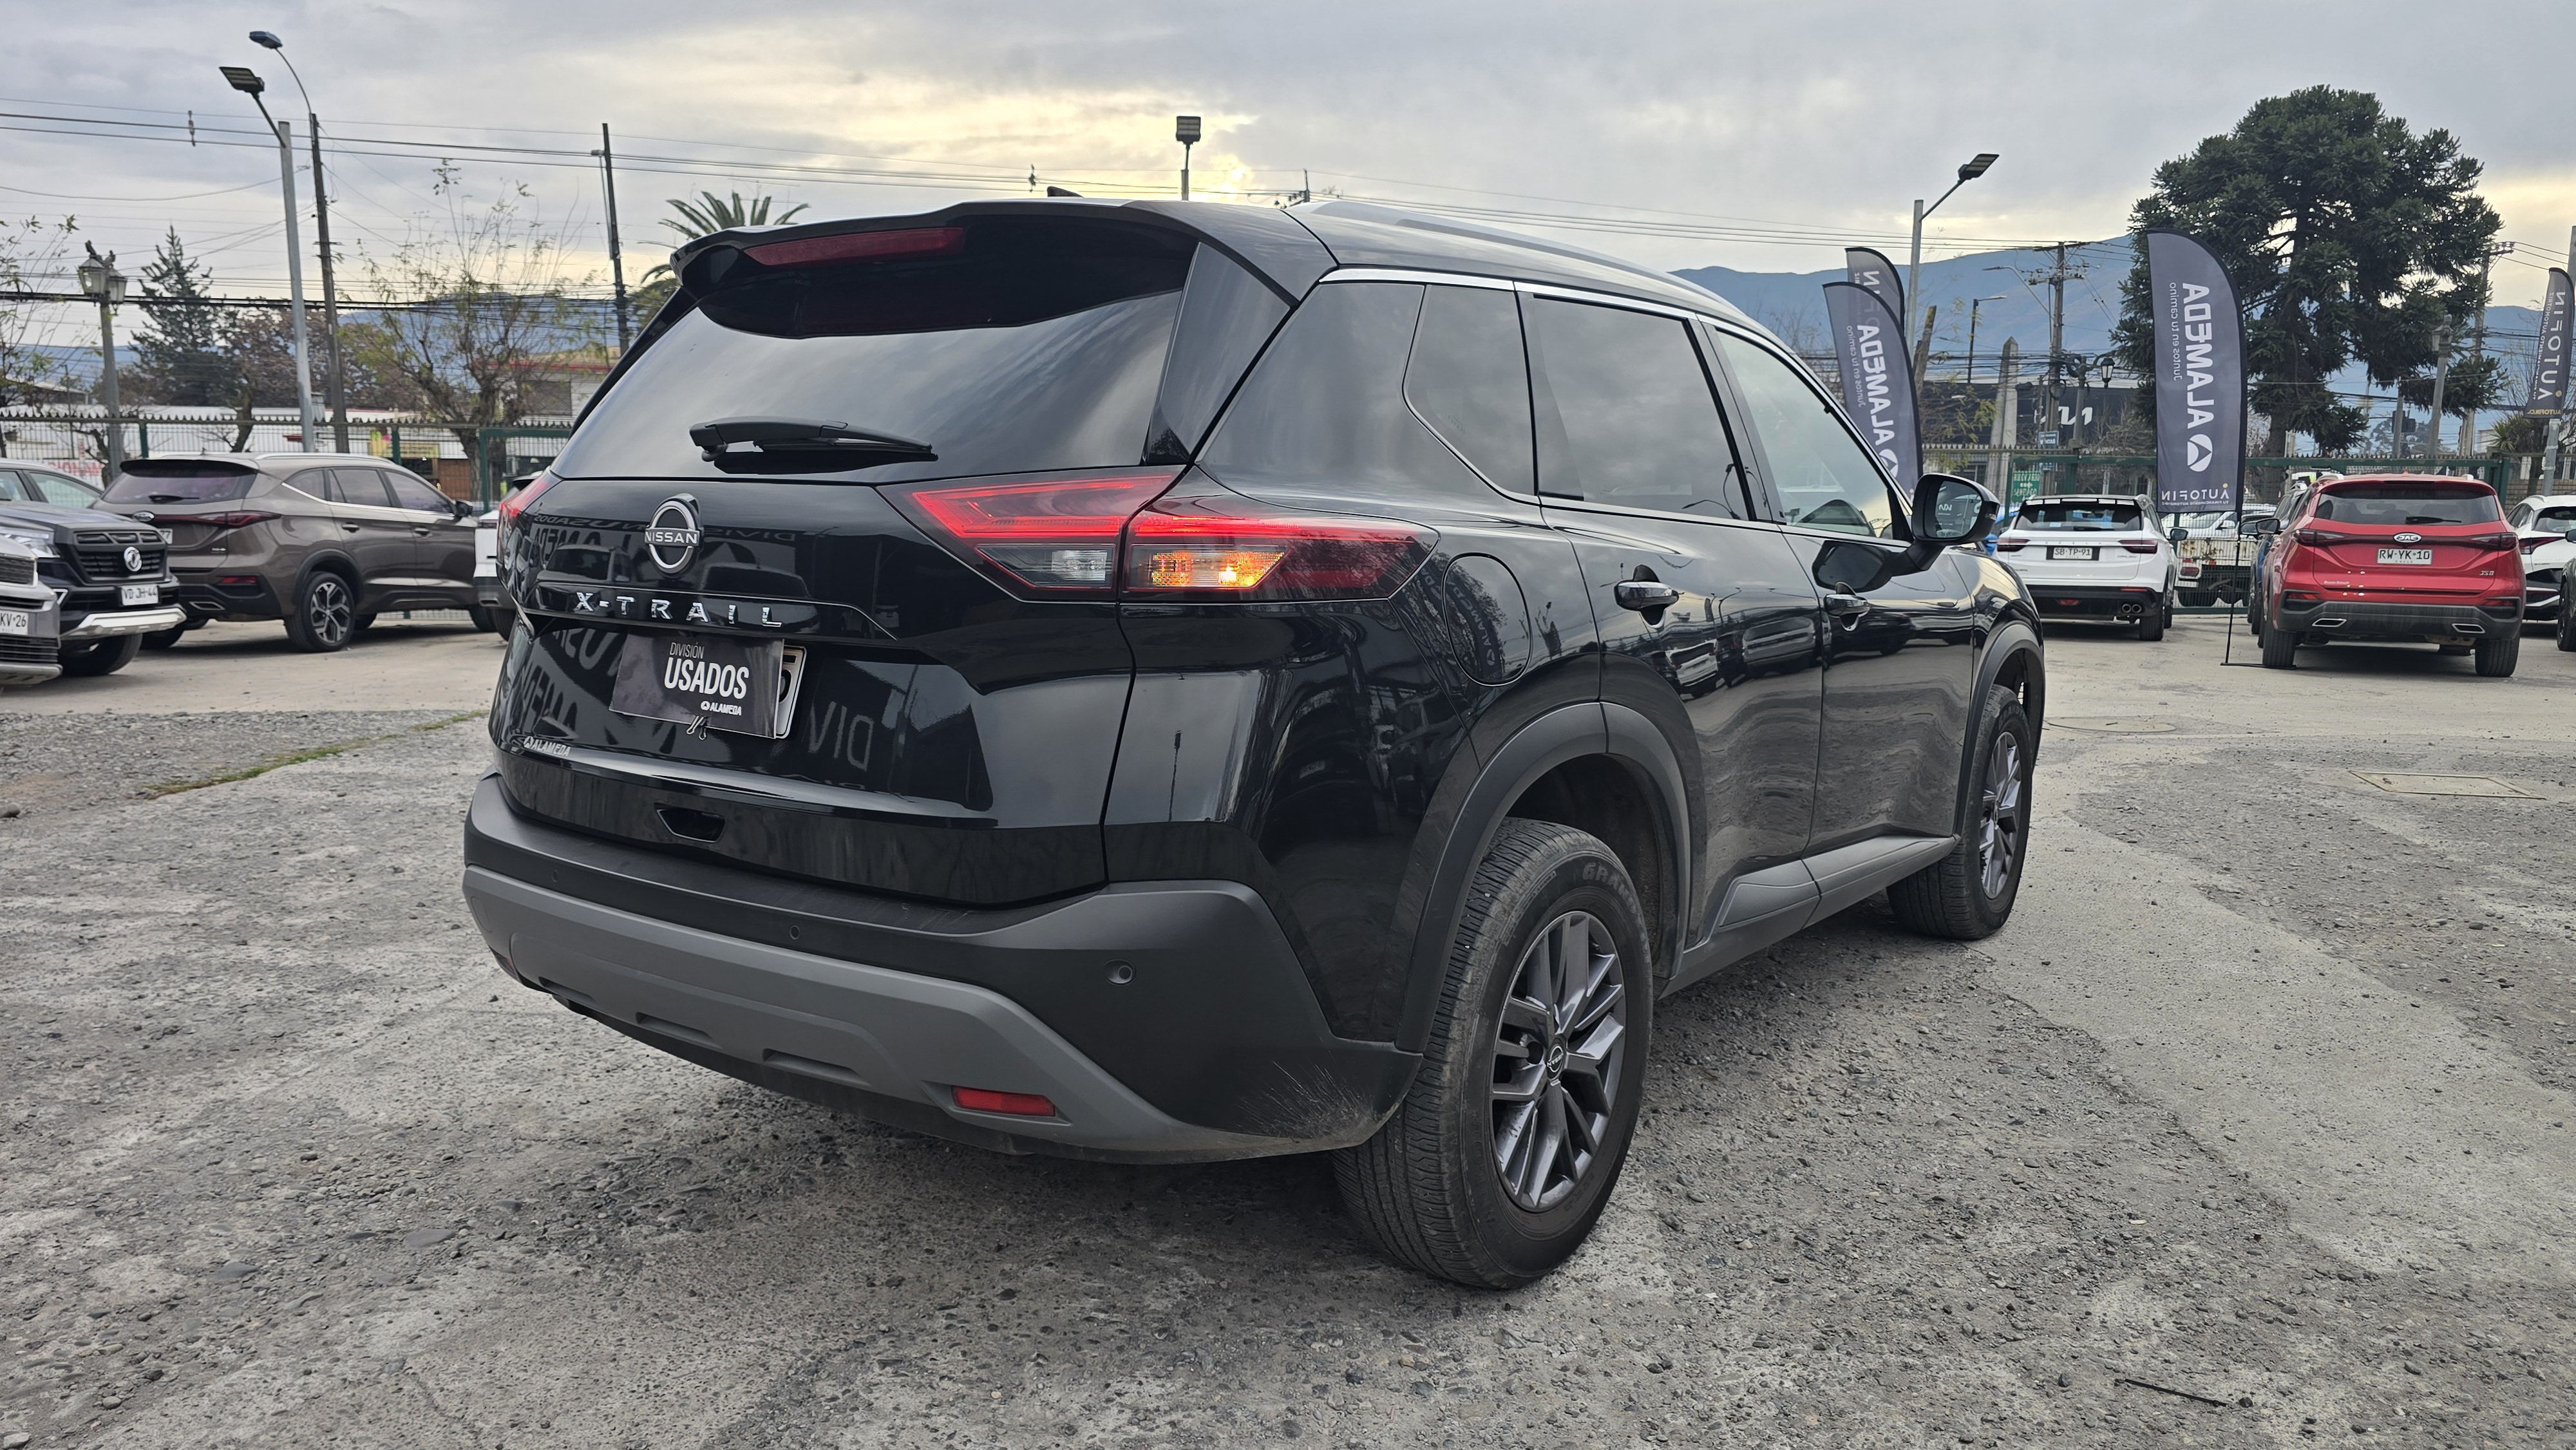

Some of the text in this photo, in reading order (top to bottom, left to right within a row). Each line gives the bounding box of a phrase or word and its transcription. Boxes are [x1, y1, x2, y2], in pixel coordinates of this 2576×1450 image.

[645, 530, 698, 545] NISSAN
[576, 592, 782, 628] X-TRAIL
[669, 642, 705, 659] DIVISIÓN
[664, 657, 750, 699] USADOS
[709, 701, 742, 716] ALAMEDA
[533, 739, 571, 757] ALAMEDA
